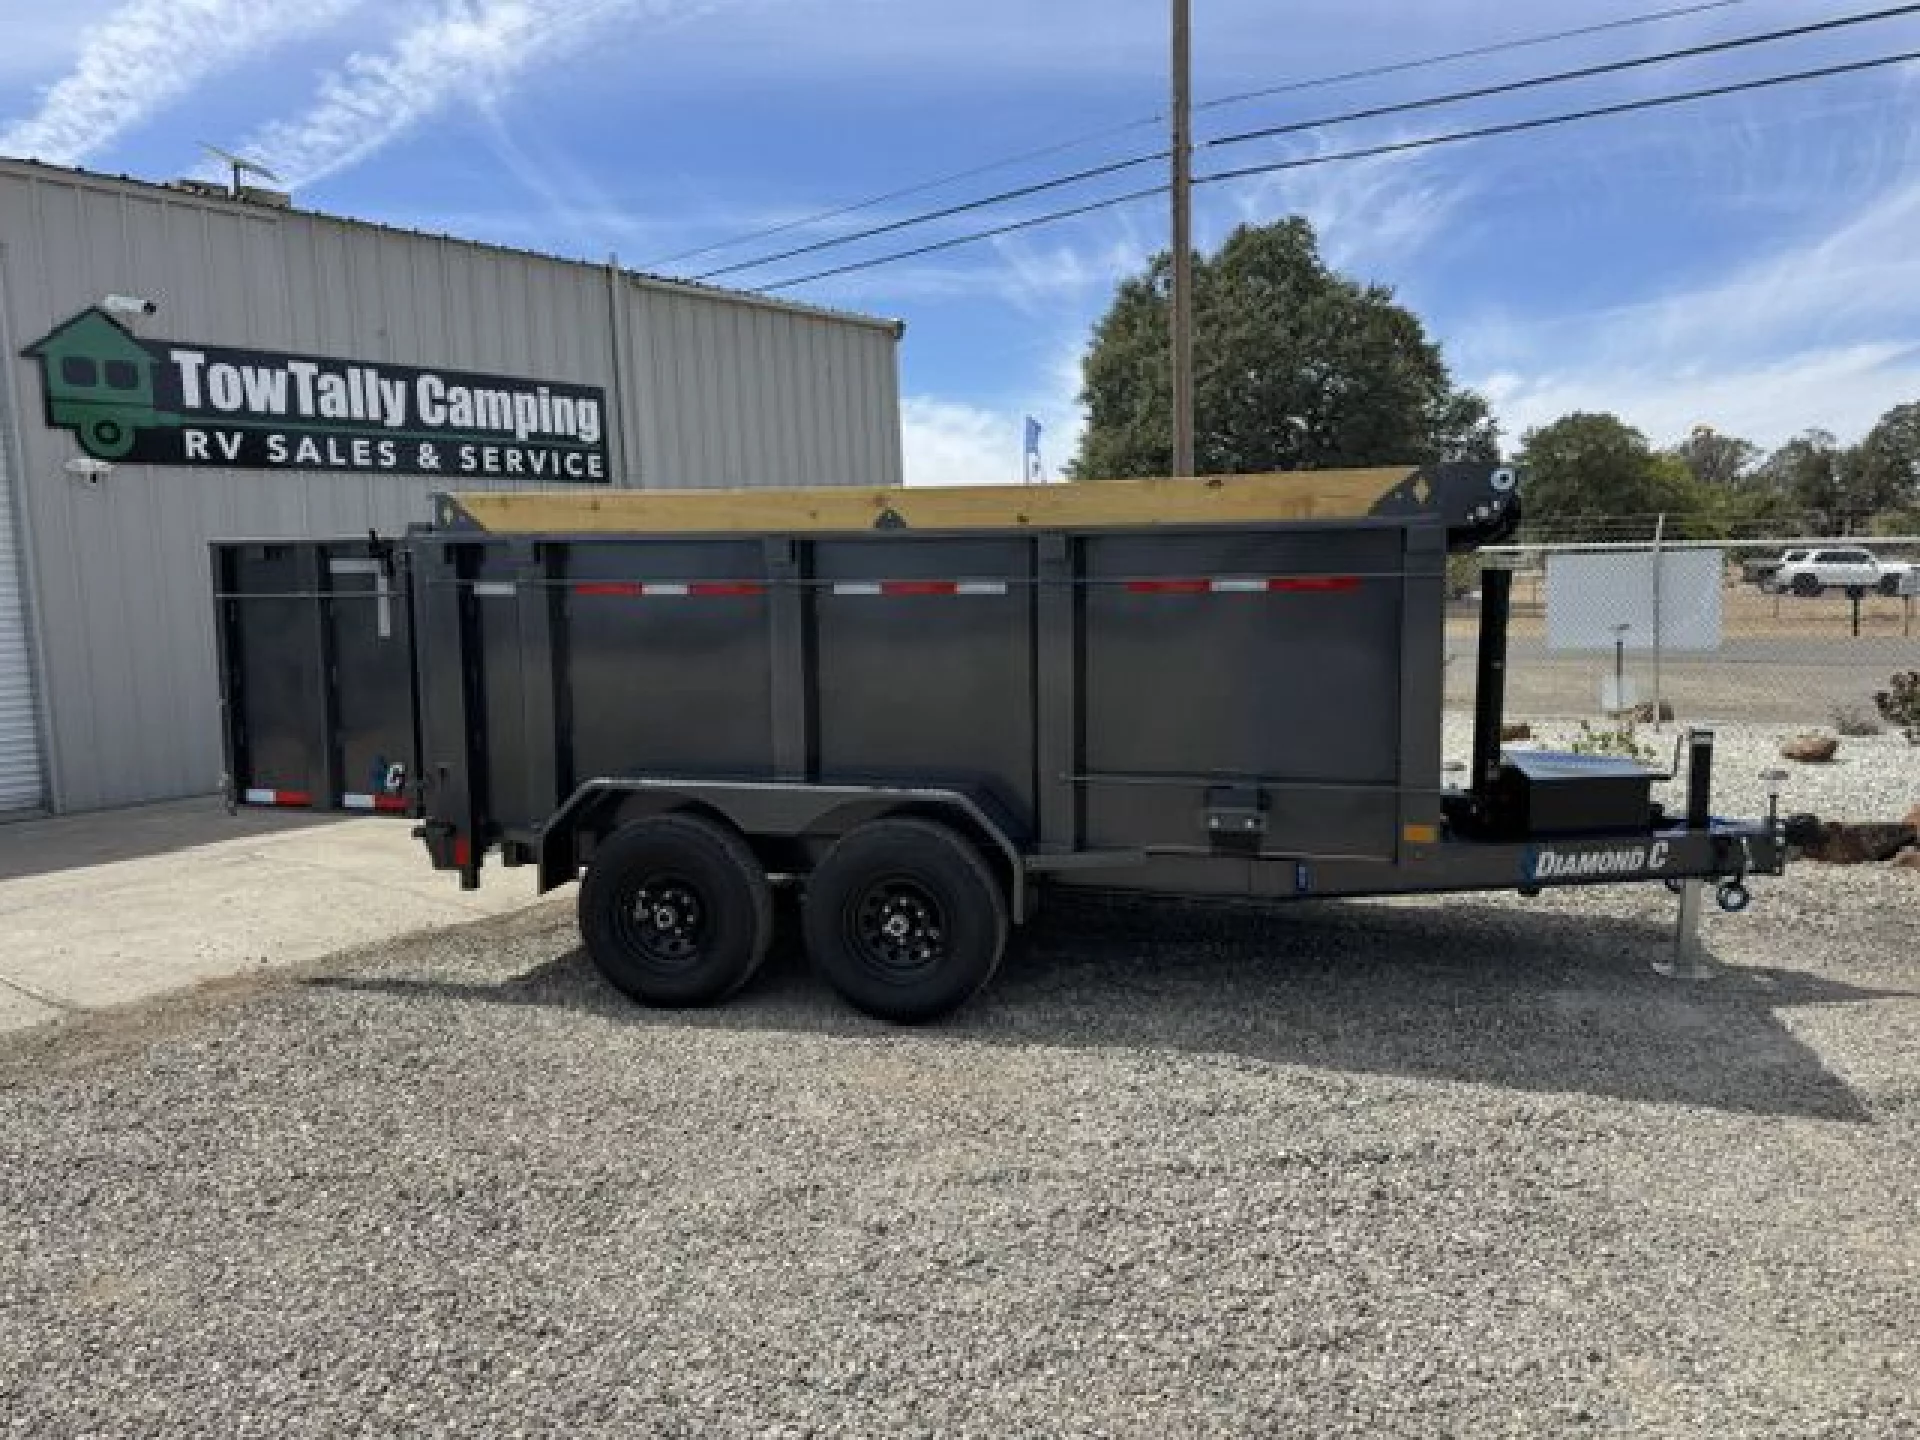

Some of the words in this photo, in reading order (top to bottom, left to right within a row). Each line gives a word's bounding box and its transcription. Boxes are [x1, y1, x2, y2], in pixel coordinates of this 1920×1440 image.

[170, 350, 406, 426] TowTally
[417, 374, 599, 443] Camping
[185, 428, 244, 460] RV
[266, 434, 398, 468] SALES
[418, 443, 441, 469] &
[460, 446, 604, 478] SERVICE
[1648, 840, 1669, 870] C
